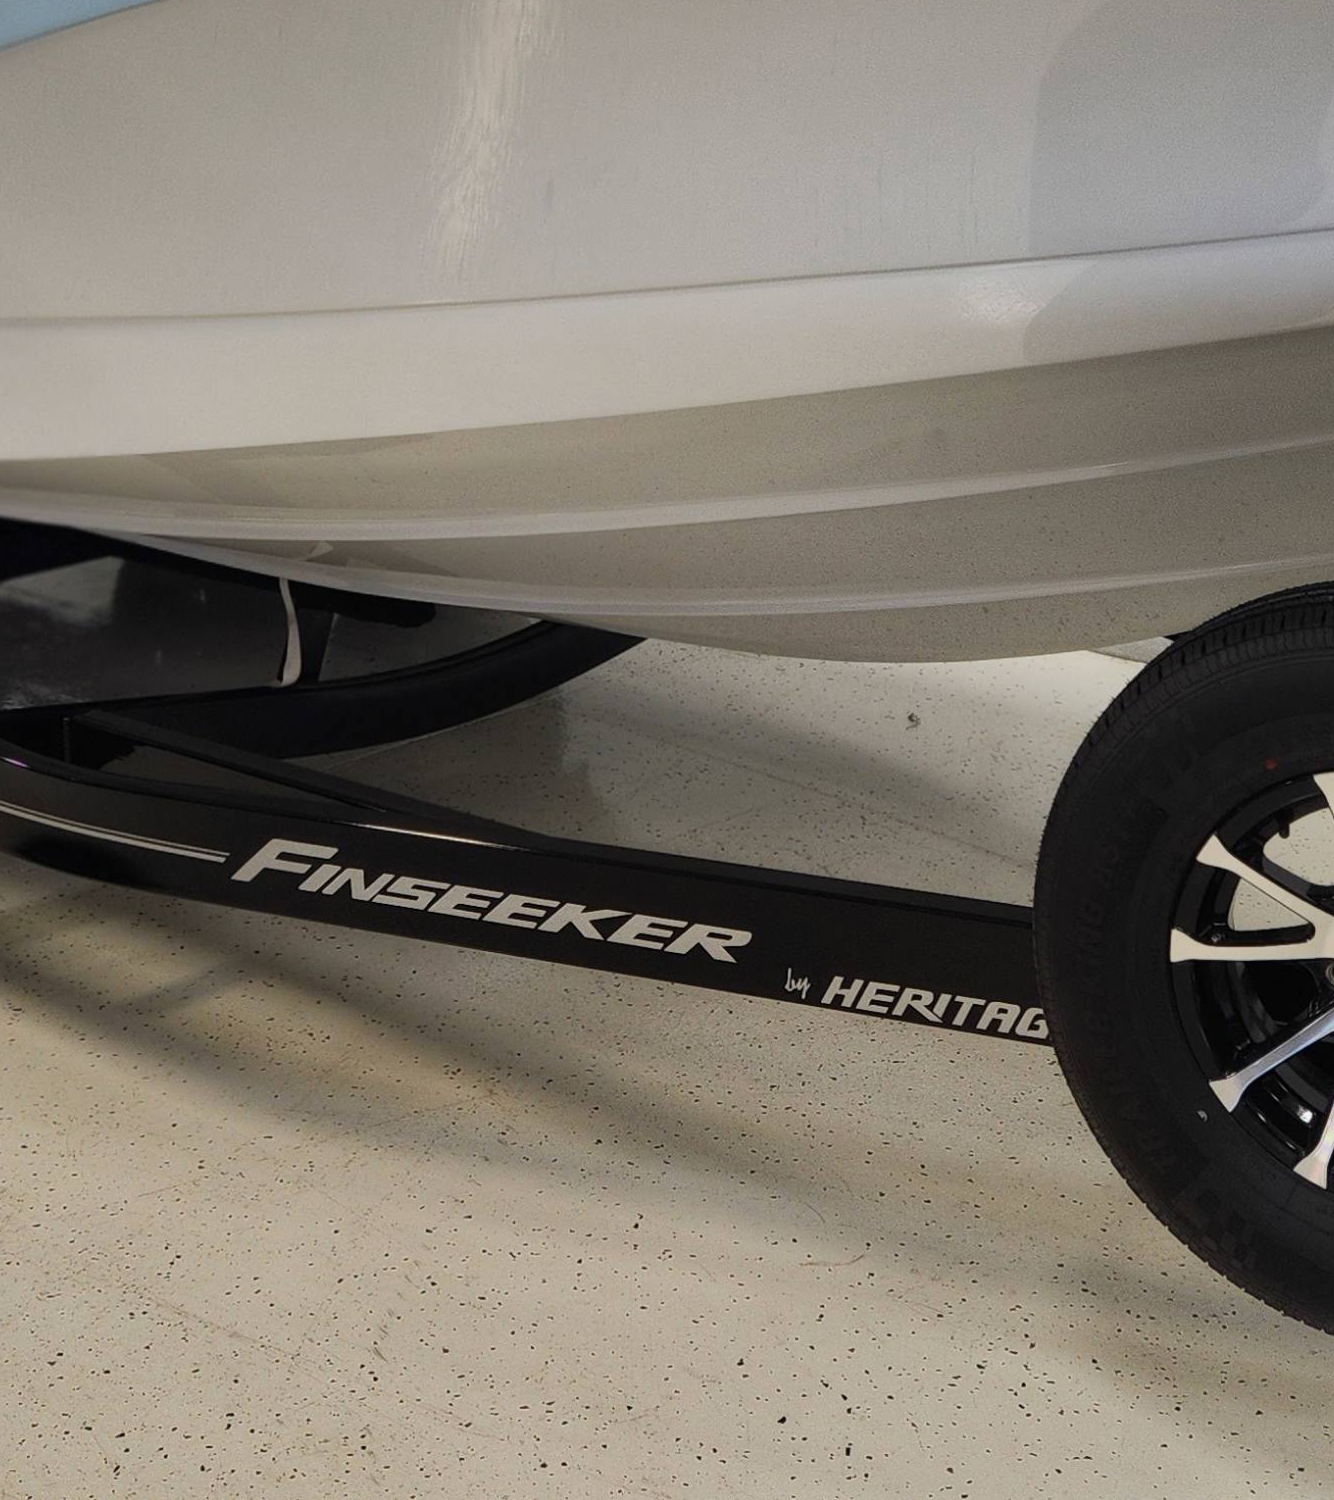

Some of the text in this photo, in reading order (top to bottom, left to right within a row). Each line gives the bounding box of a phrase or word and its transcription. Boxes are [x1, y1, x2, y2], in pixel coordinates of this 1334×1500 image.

[230, 837, 754, 965] FINSEEKER
[784, 967, 1050, 1040] by HERITAG
